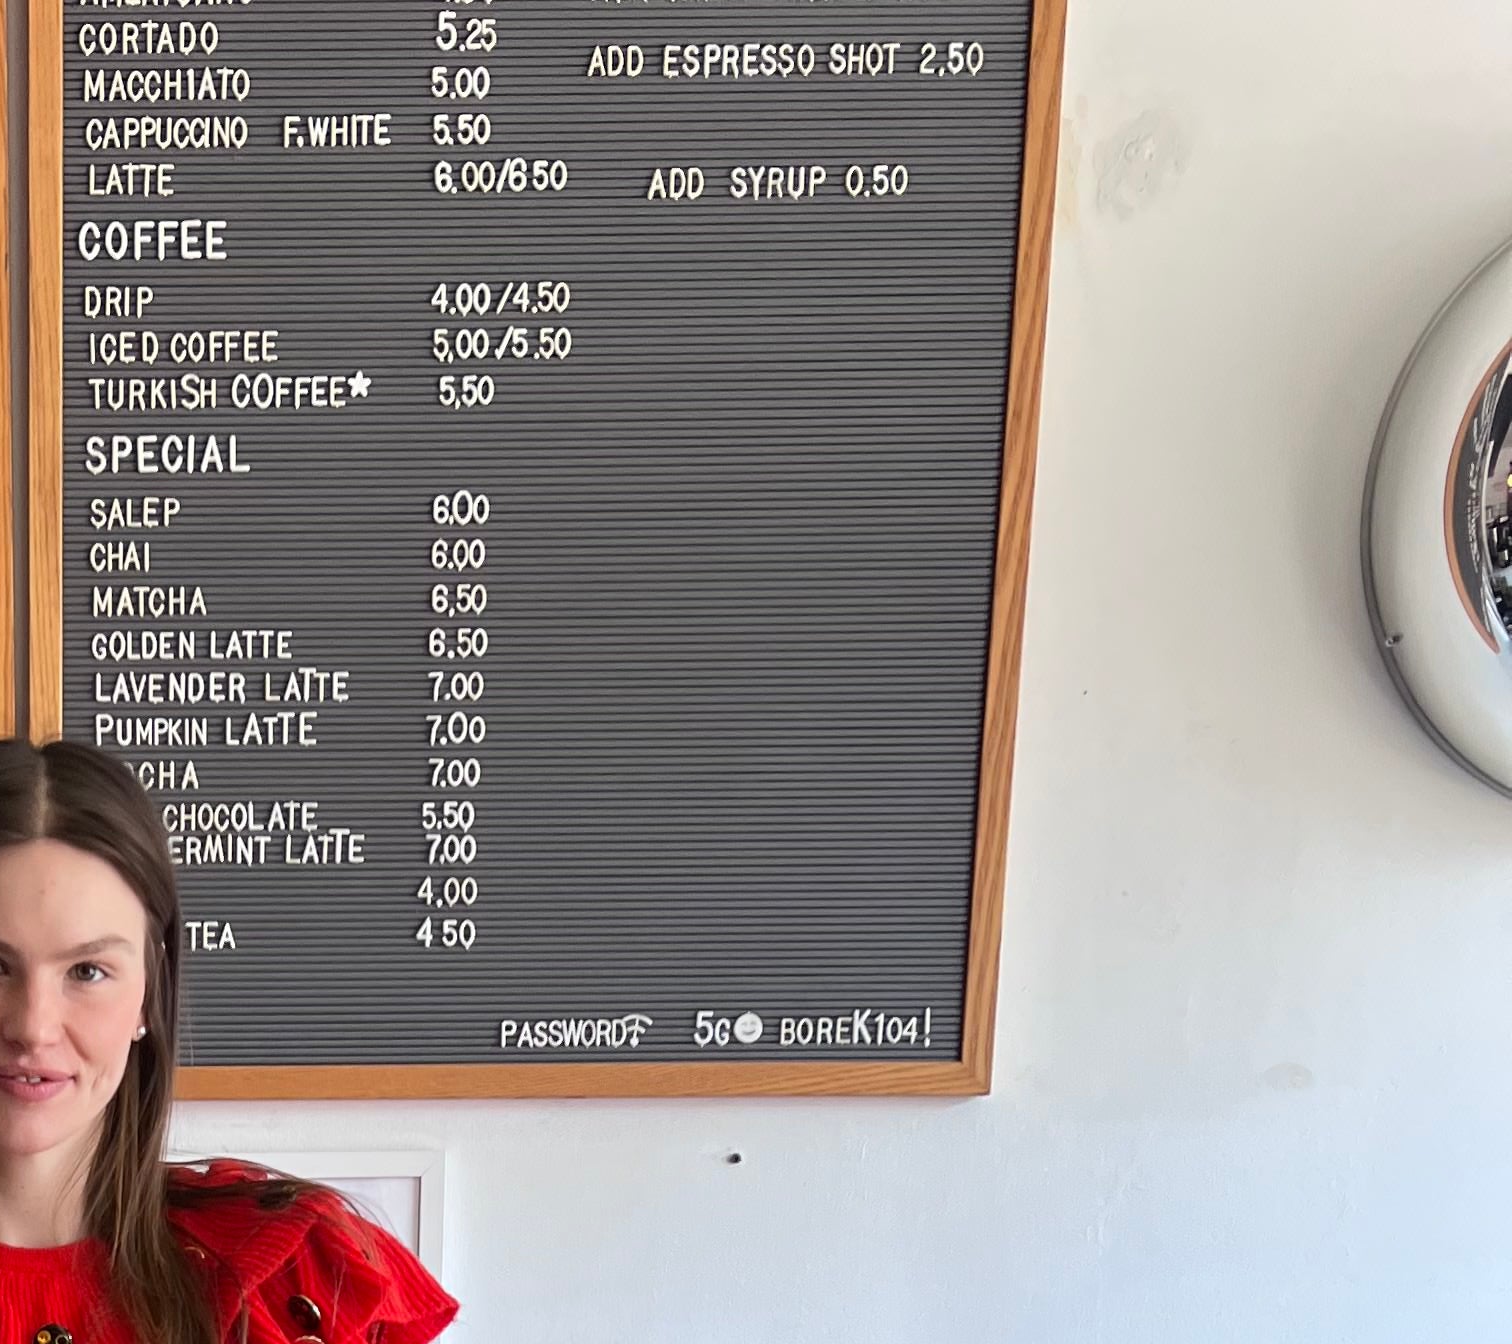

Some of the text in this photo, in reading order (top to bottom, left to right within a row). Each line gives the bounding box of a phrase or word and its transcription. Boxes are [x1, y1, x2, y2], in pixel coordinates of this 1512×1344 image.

[79, 9, 497, 57] CORTADO 5.25
[587, 45, 644, 77] ADD
[663, 43, 815, 80] ESPRESSO
[829, 42, 901, 77] SHOT
[431, 66, 491, 100] 5.00
[86, 115, 248, 151] CAPPUCCINO
[433, 113, 491, 145] 5.50
[89, 162, 175, 198] LATTE
[647, 164, 909, 201] ADD SYRUP 0.50
[78, 219, 227, 262] COFFEE
[84, 285, 154, 319] DRIP
[90, 331, 159, 366] ICED
[170, 330, 279, 364] COFFEE
[88, 373, 217, 412] TURKISH
[85, 434, 251, 476] SPECIAL
[90, 497, 181, 531] SALEP
[90, 538, 486, 573] CHAI 6.00
[93, 586, 207, 618] MATCHA
[91, 627, 489, 662] GOLDEN LATTE 6.50
[95, 667, 485, 705] LAVENDER LATTE 7.00
[95, 711, 486, 747] PUMPKIN LATTE 7.00
[428, 758, 481, 788] 7.00
[162, 800, 319, 833] CHOCOLATE
[285, 828, 365, 865] LATTE
[184, 921, 236, 952] TEA
[501, 1019, 626, 1049] PASSWORD
